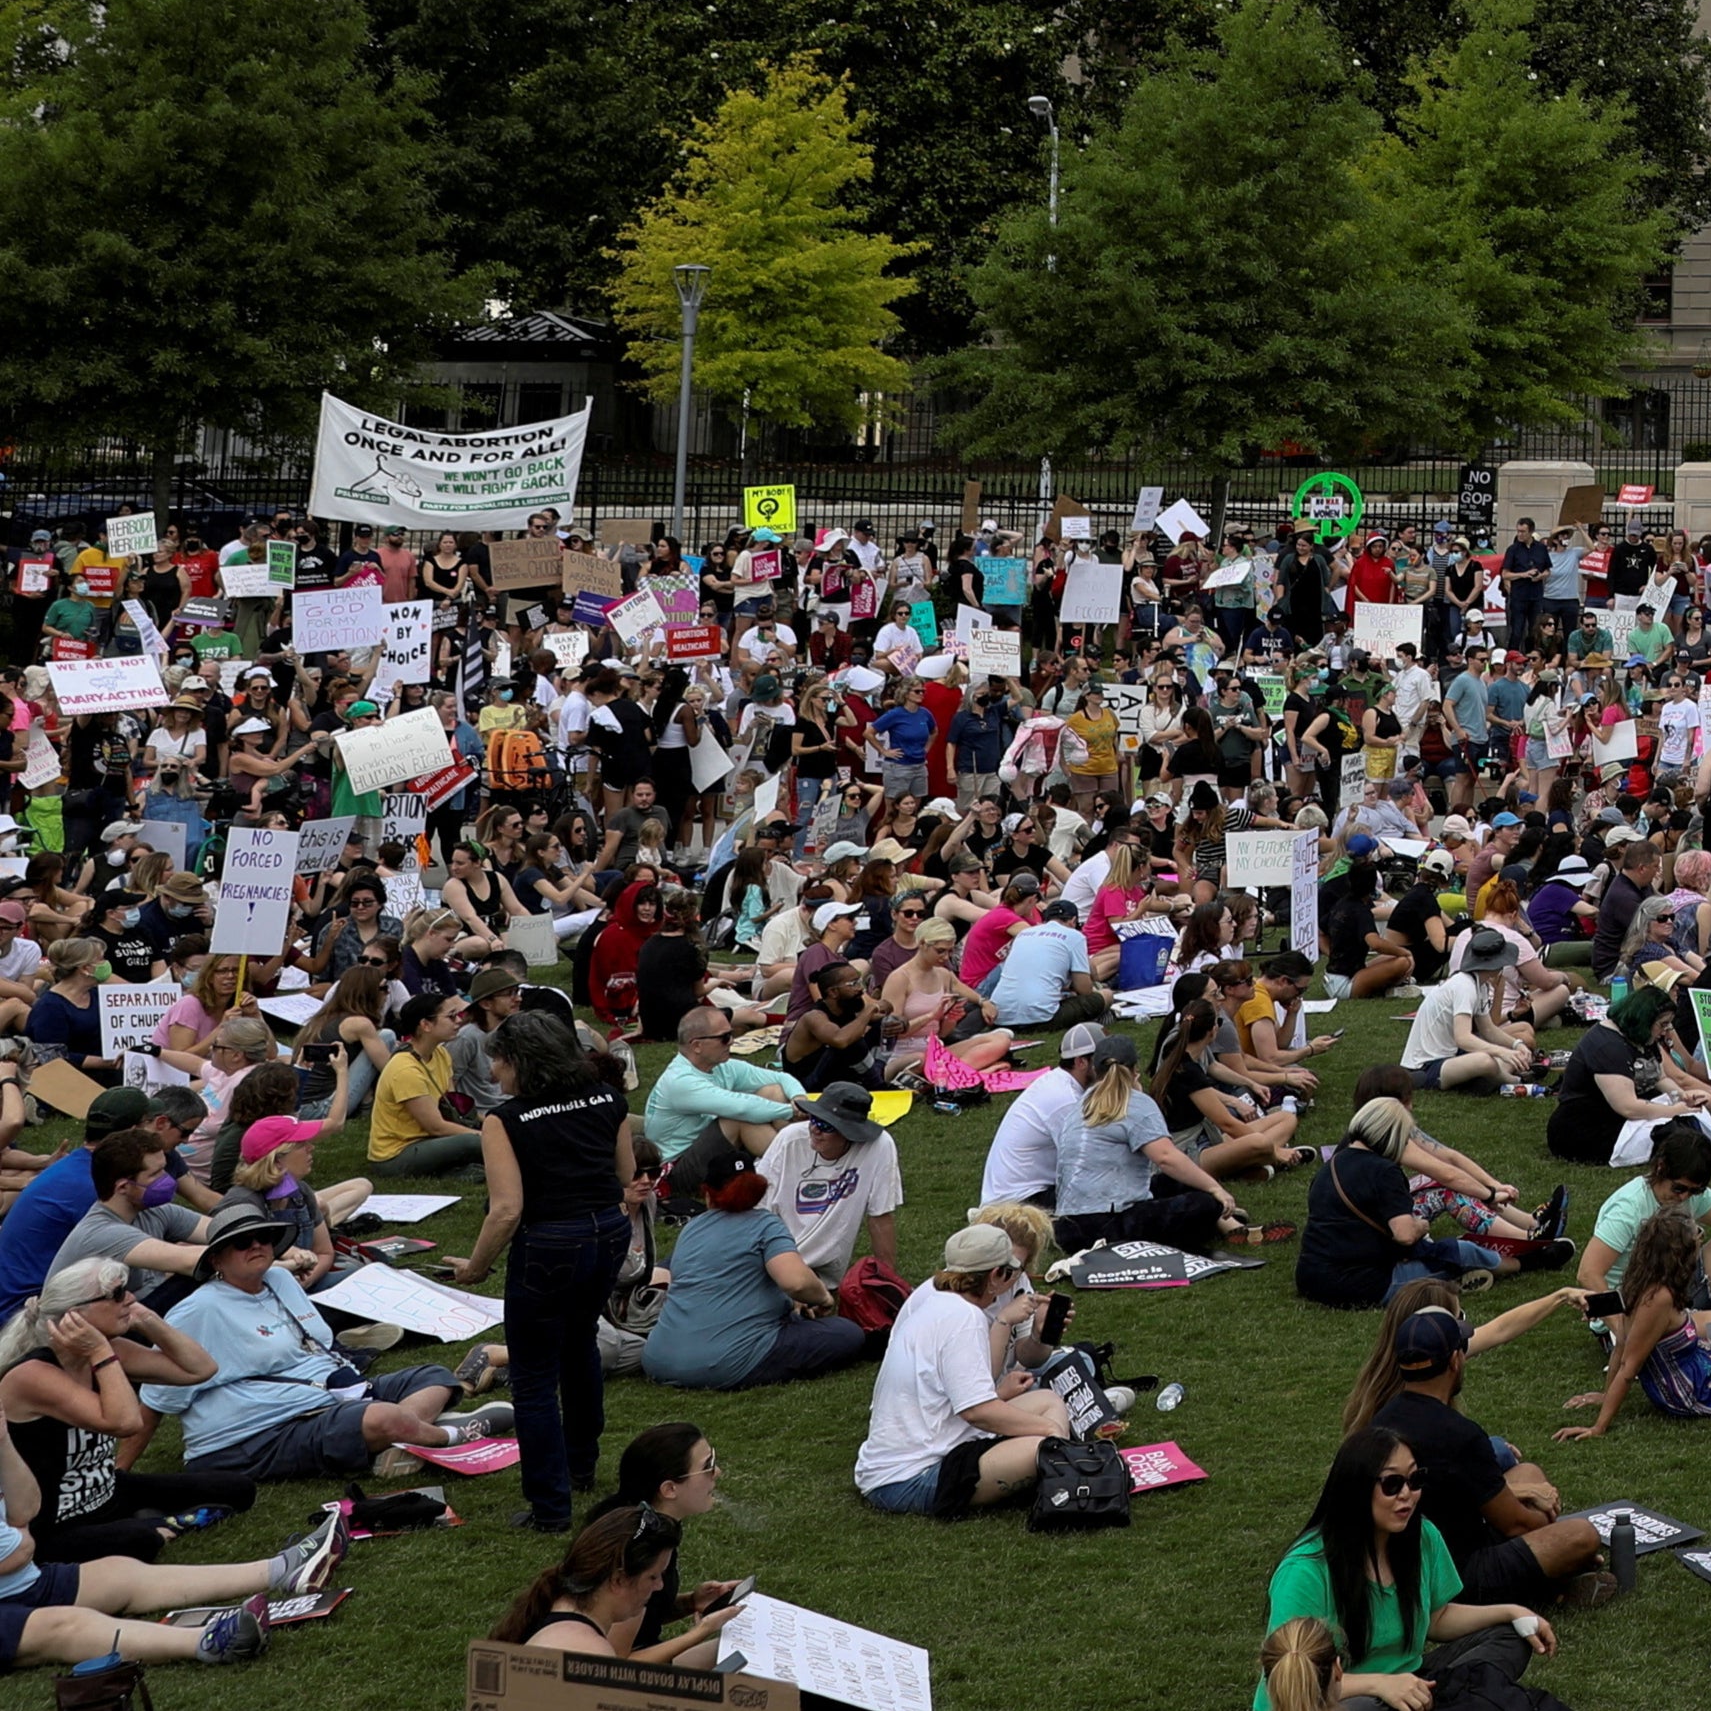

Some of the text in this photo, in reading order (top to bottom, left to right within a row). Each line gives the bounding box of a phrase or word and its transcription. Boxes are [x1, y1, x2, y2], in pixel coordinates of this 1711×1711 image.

[360, 419, 554, 448] LEGAL ABORTION
[344, 432, 567, 464] ONCE AND FOR ALL!
[444, 457, 565, 481] WE WON'T GO BACK
[435, 473, 565, 495] WE WILL FIGHT BACK!
[1469, 471, 1491, 484] NO
[422, 502, 448, 512] PARTY
[450, 502, 466, 511] FOR
[522, 494, 569, 506] LIBERATION
[1461, 492, 1492, 505] GOP
[1314, 509, 1340, 518] WOMEN
[569, 555, 616, 574] GINGERS
[300, 590, 374, 607] I THANK
[611, 590, 650, 619] NO UTERUS
[306, 602, 365, 617] GOD
[389, 606, 421, 622] MOM
[307, 615, 359, 628] FOR MY
[1370, 617, 1405, 630] RIGHTS
[299, 625, 380, 649] ABORTION
[396, 627, 412, 640] BY
[673, 628, 709, 640] ABORTIONS
[971, 630, 993, 641] VOTE
[1376, 630, 1394, 640] ARE
[381, 642, 428, 665] CHOICE
[559, 643, 577, 652] OFF
[672, 640, 711, 652] HEALTHCARE
[562, 651, 577, 659] MY
[55, 657, 147, 672] WE ARE NOT
[58, 687, 165, 705] OVARY-ACTING
[1704, 700, 1711, 710] I
[384, 732, 413, 750] have
[347, 744, 428, 776] Fundamental
[353, 749, 454, 791] HUMAN RIGHTS
[385, 821, 396, 835] IS
[252, 830, 273, 846] NO
[301, 827, 344, 848] this is
[1236, 839, 1294, 856] MY FUTURE
[231, 848, 283, 869] FORCED
[1236, 855, 1292, 871] MY CHOICE
[220, 884, 290, 900] PREGNANCIES
[106, 993, 178, 1008] SEPARATION
[110, 1014, 126, 1028] OF
[113, 1035, 136, 1050] AND
[519, 1098, 588, 1123] INDIVISIBLE
[1087, 1266, 1163, 1281] Abortion is
[1088, 1272, 1172, 1285] Health Care.
[1127, 1453, 1153, 1477] OFF
[1145, 1450, 1178, 1472] BANS
[567, 1660, 721, 1695] DISPLAY BOARD WITH HEADER
